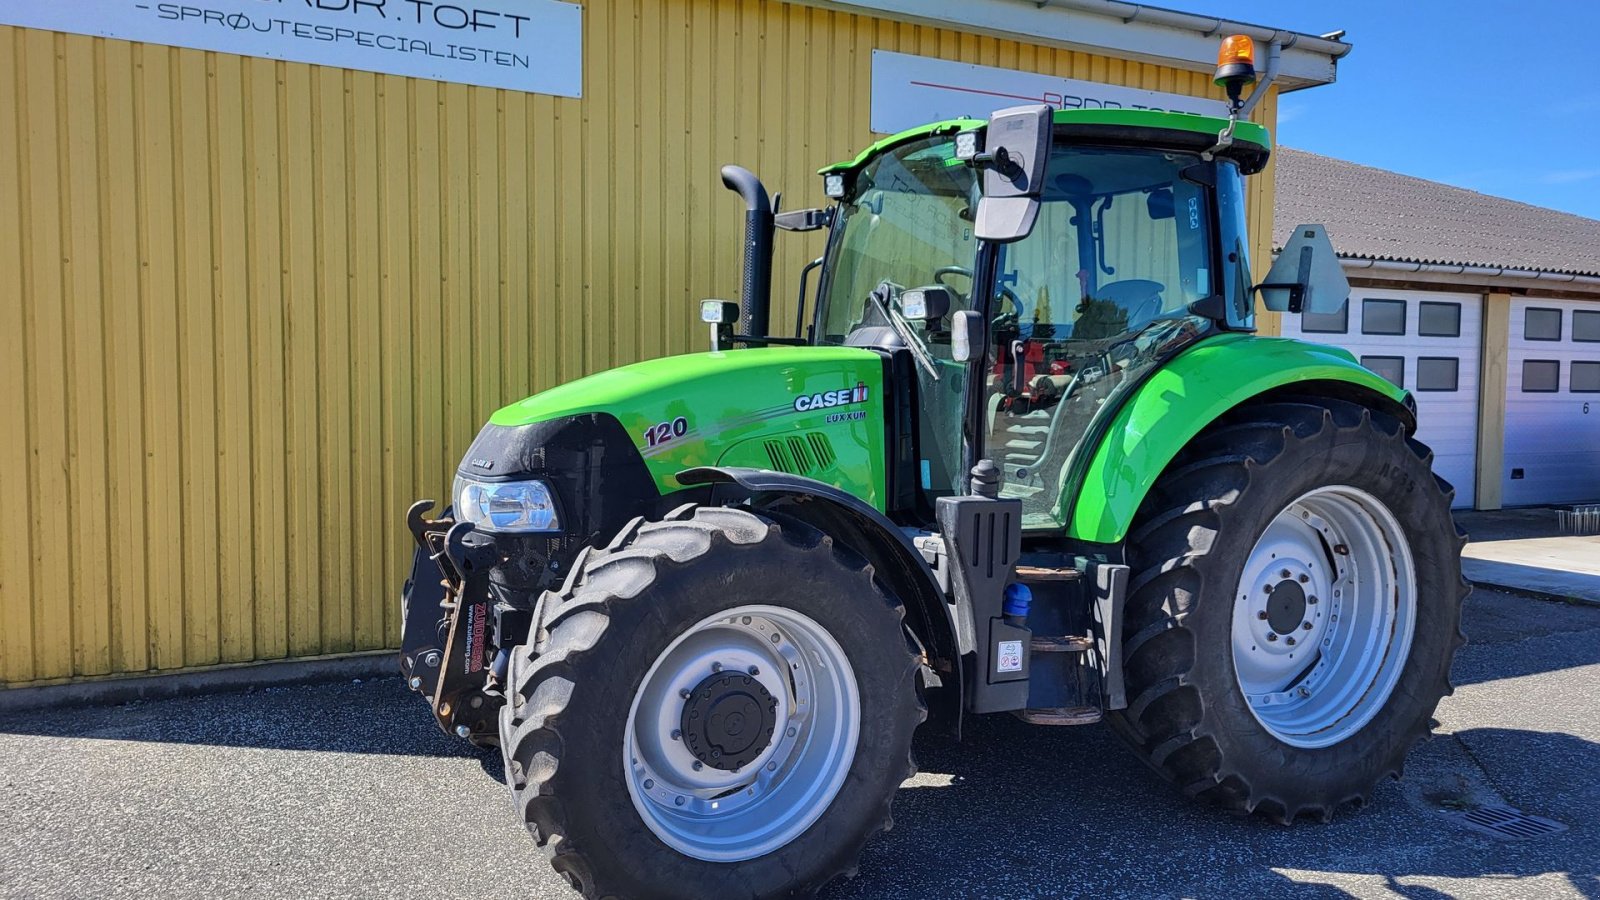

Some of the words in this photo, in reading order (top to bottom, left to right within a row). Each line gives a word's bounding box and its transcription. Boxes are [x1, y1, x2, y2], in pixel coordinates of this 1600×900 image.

[157, 3, 529, 69] SPRØJTESPECIALISTEN
[262, 0, 531, 39] R.TOFT
[794, 389, 851, 412] CASE
[826, 410, 867, 424] LUXXUM
[1583, 402, 1589, 414] 6
[643, 416, 688, 448] 120
[464, 604, 474, 675] www.zuidberg.com
[470, 602, 487, 673] ZUIDBERG
